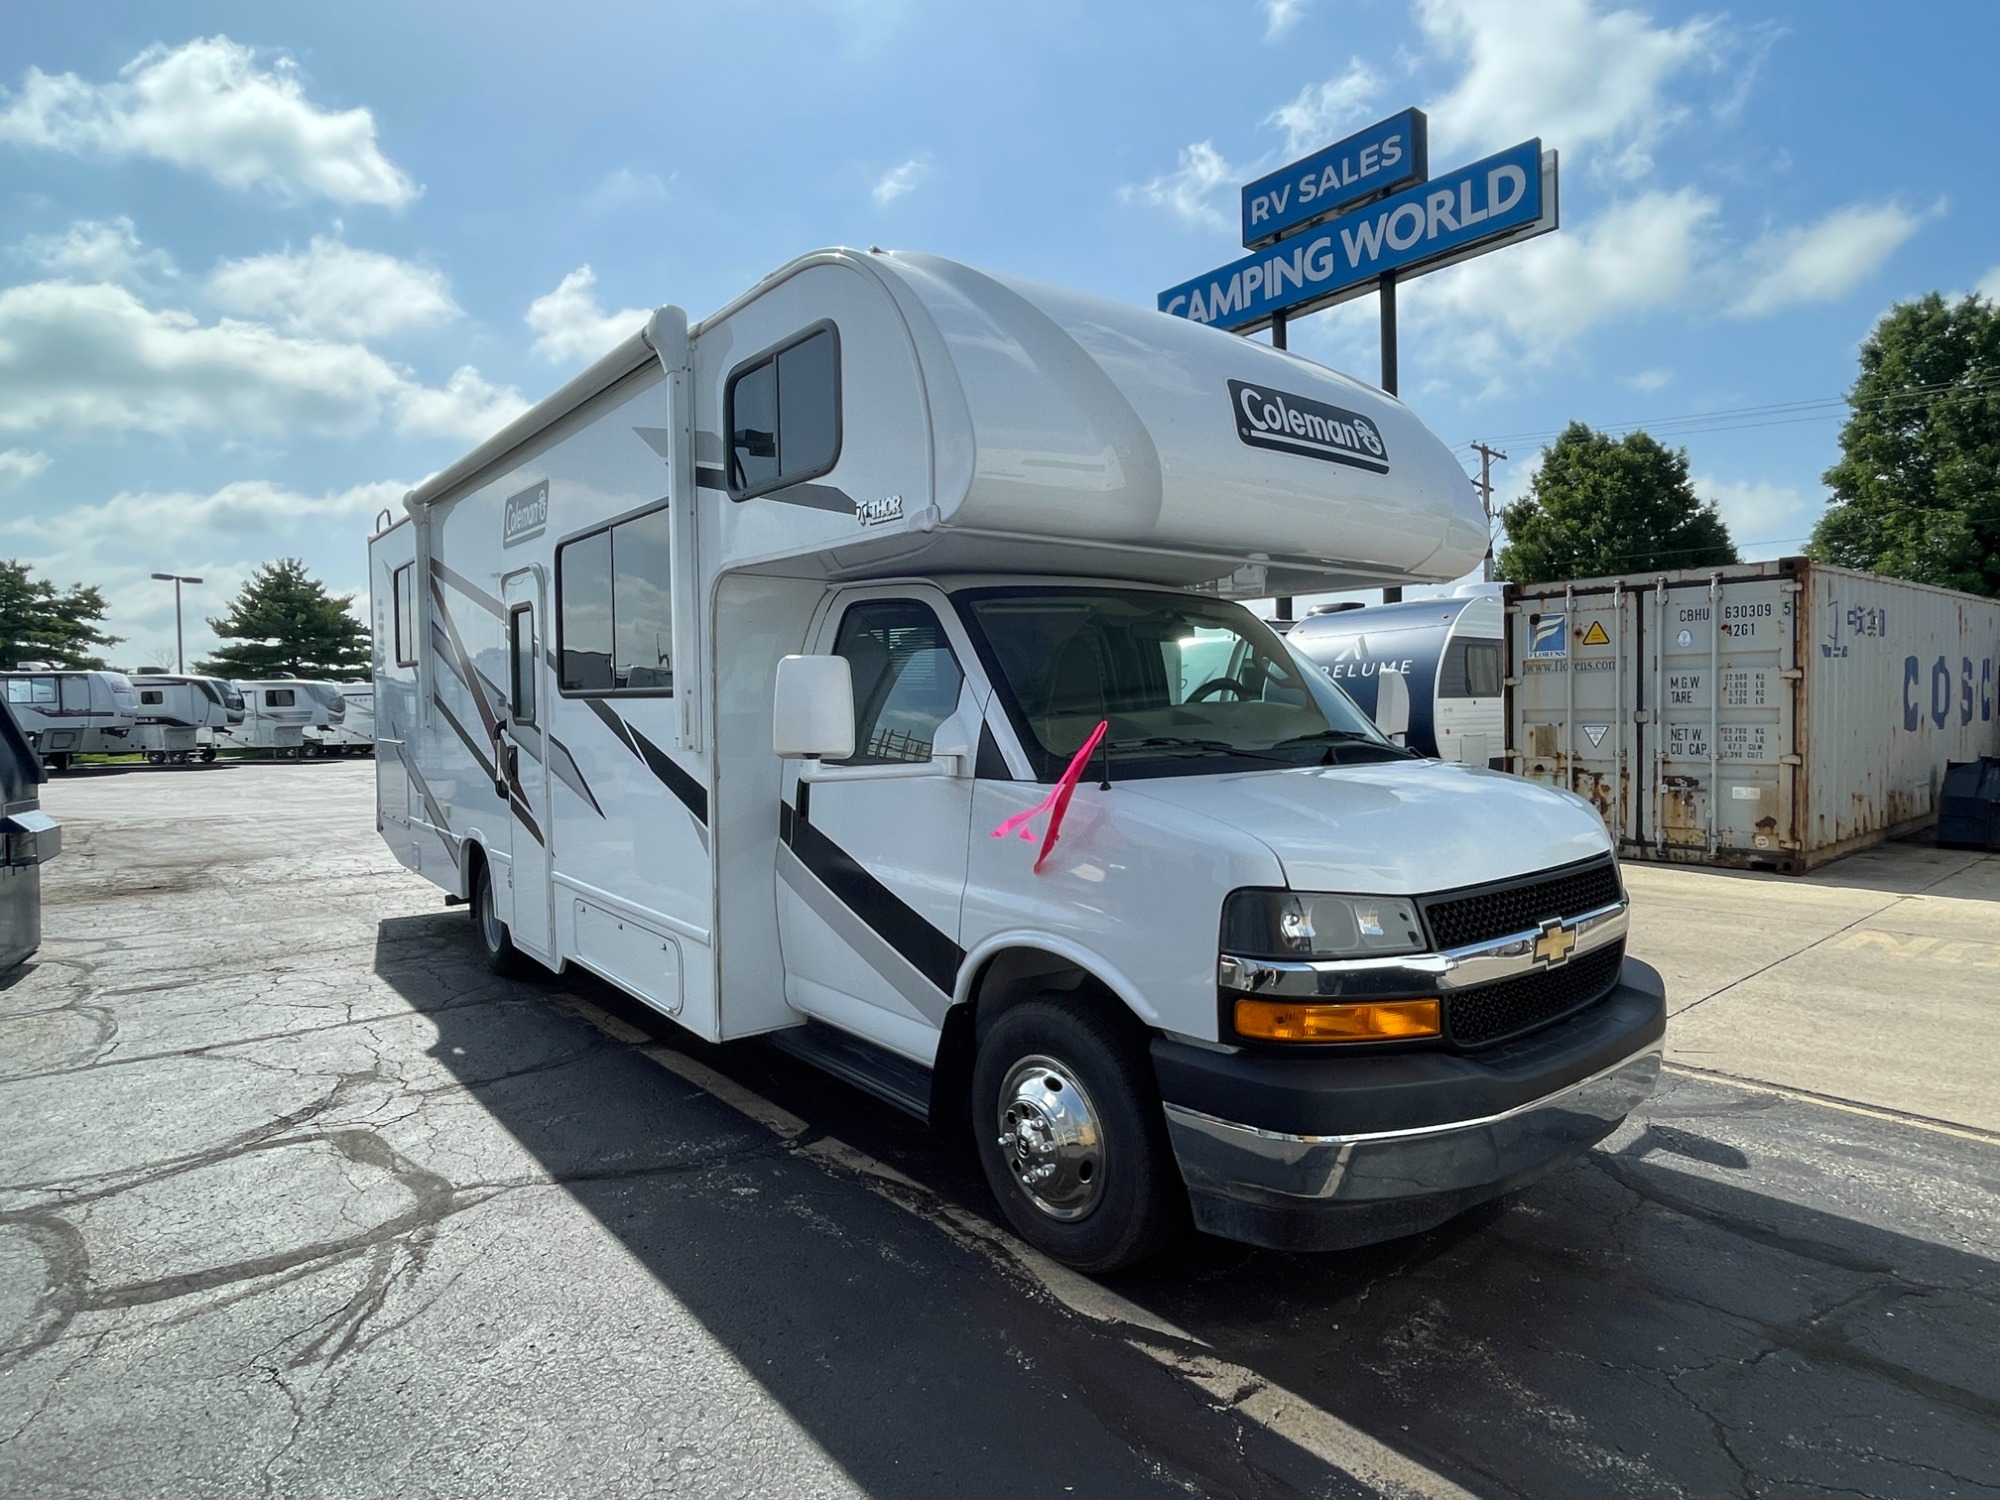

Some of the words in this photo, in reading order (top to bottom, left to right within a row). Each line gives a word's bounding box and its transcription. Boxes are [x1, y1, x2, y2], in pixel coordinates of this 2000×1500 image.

[1251, 183, 1291, 226] RV
[1298, 134, 1403, 203] SALES
[1340, 163, 1527, 269] WORLD
[1240, 387, 1361, 450] Coleman
[506, 500, 539, 536] Coleman
[1680, 607, 1710, 622] CBHU
[1724, 603, 1772, 619] 630309
[1783, 601, 1791, 616] 5
[1726, 622, 1755, 637] 42G1
[1671, 691, 1693, 704] TARE
[1670, 729, 1689, 741] NET
